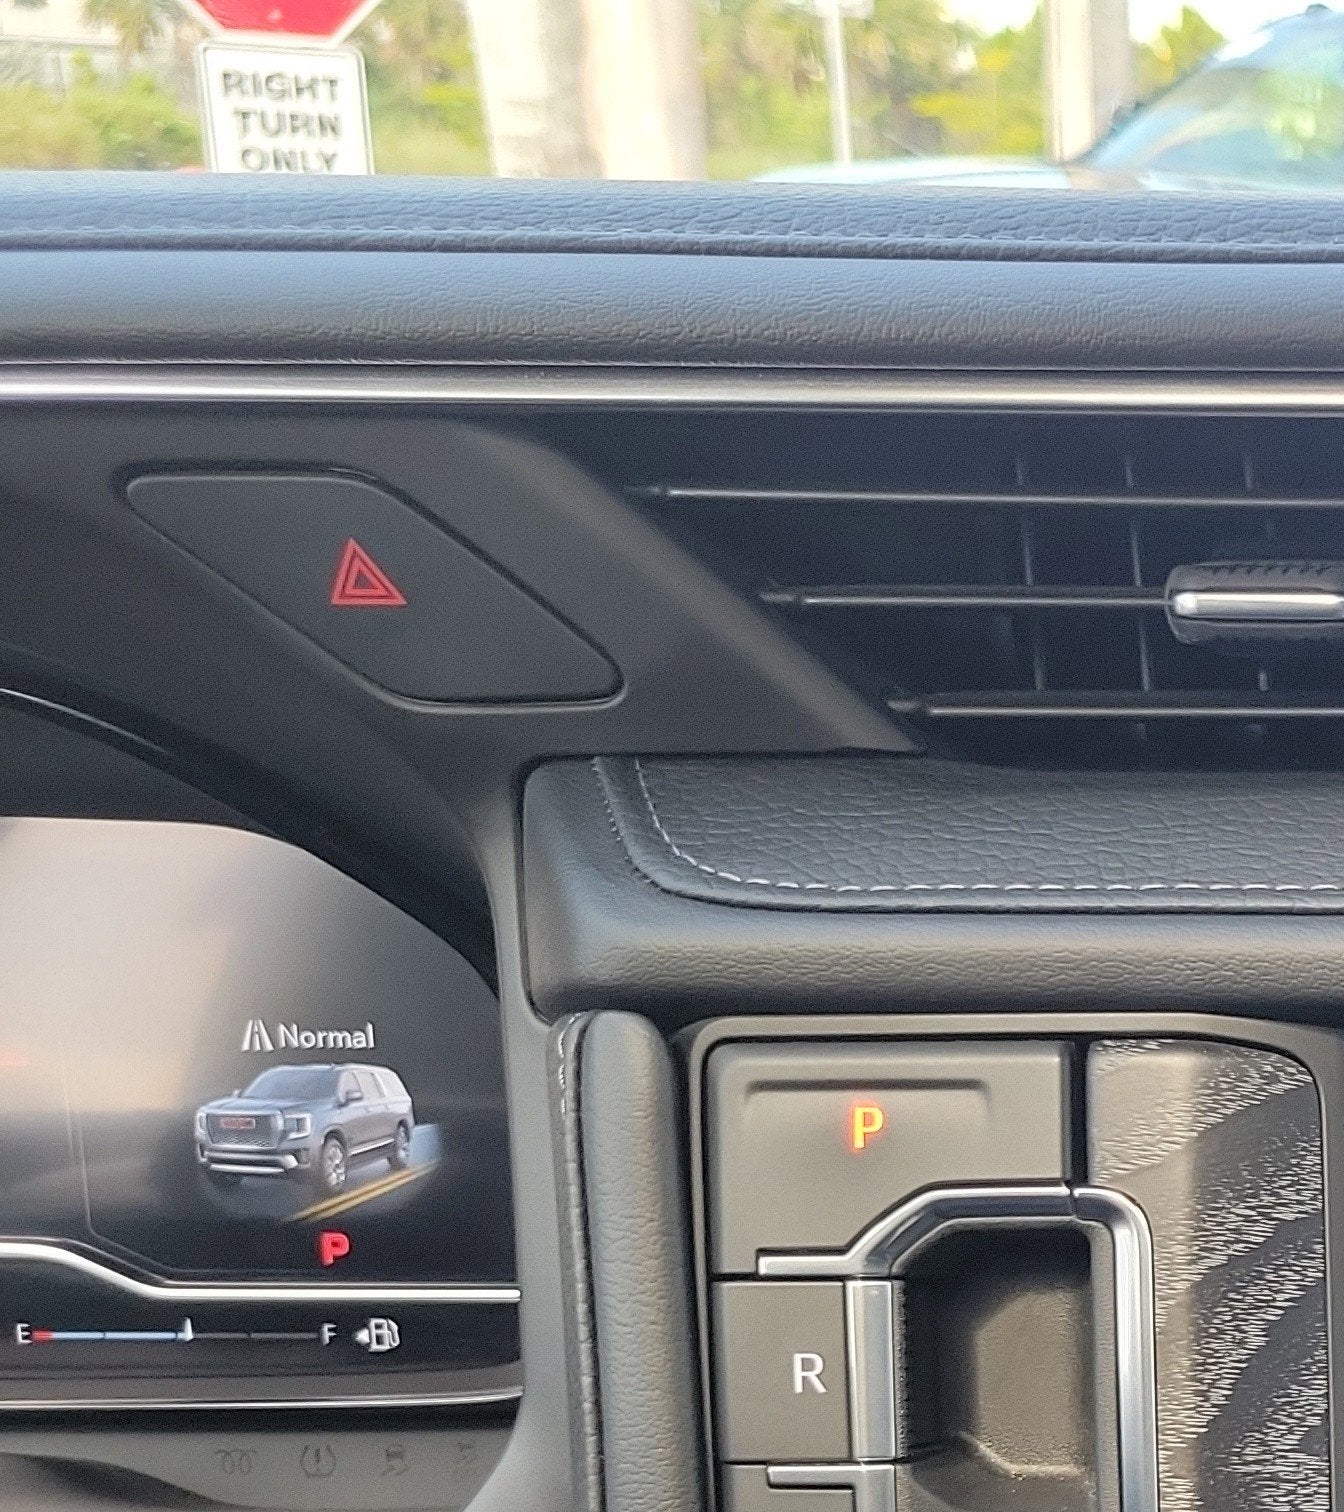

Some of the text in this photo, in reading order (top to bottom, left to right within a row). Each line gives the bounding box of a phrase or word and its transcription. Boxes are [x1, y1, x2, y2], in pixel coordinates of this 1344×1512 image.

[222, 70, 340, 102] RIGHT
[233, 109, 342, 138] TURN
[241, 147, 338, 174] ONLY
[278, 1022, 375, 1050] Normal
[852, 1106, 884, 1149] P
[318, 1231, 351, 1267] P
[16, 1324, 31, 1344] E
[321, 1324, 338, 1345] F
[792, 1352, 828, 1394] R
